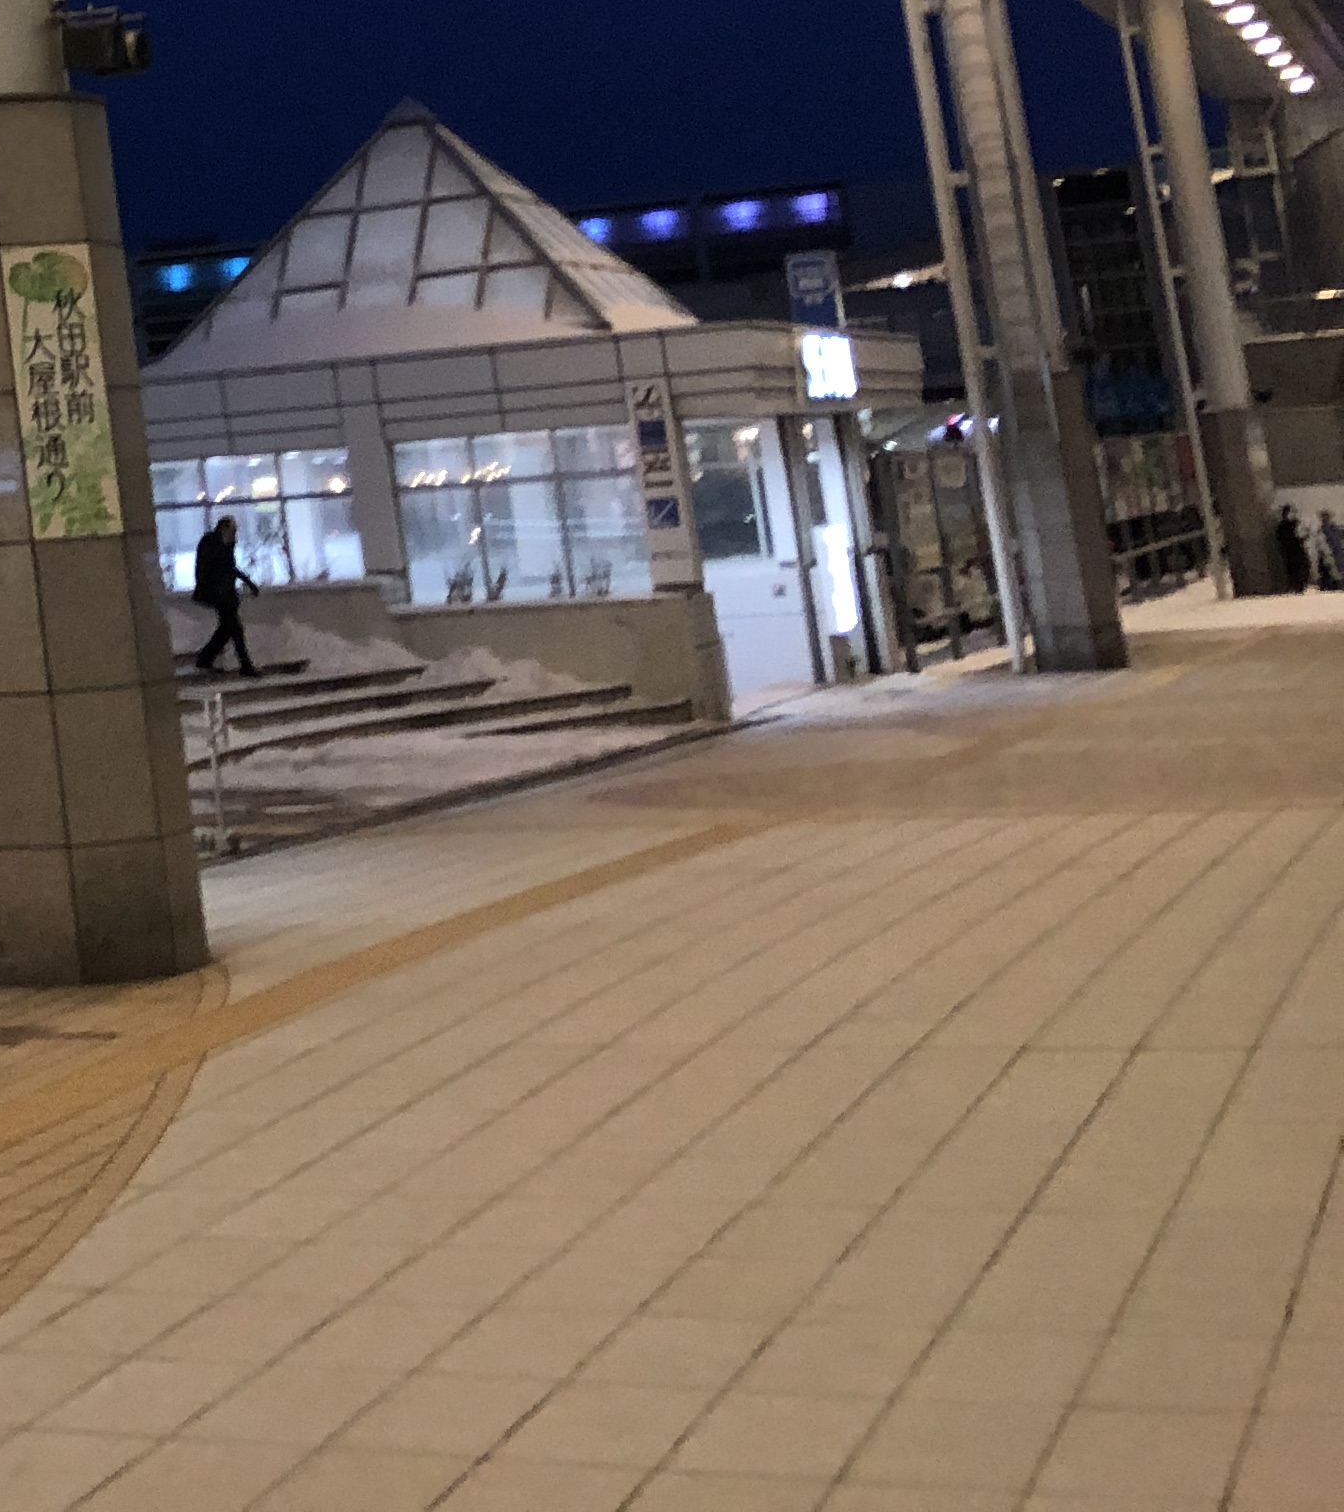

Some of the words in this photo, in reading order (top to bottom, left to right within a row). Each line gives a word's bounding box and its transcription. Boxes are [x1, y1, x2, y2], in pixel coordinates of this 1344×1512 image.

[22, 327, 70, 502] 大屋根通り
[52, 287, 95, 425] 秋田駅前
